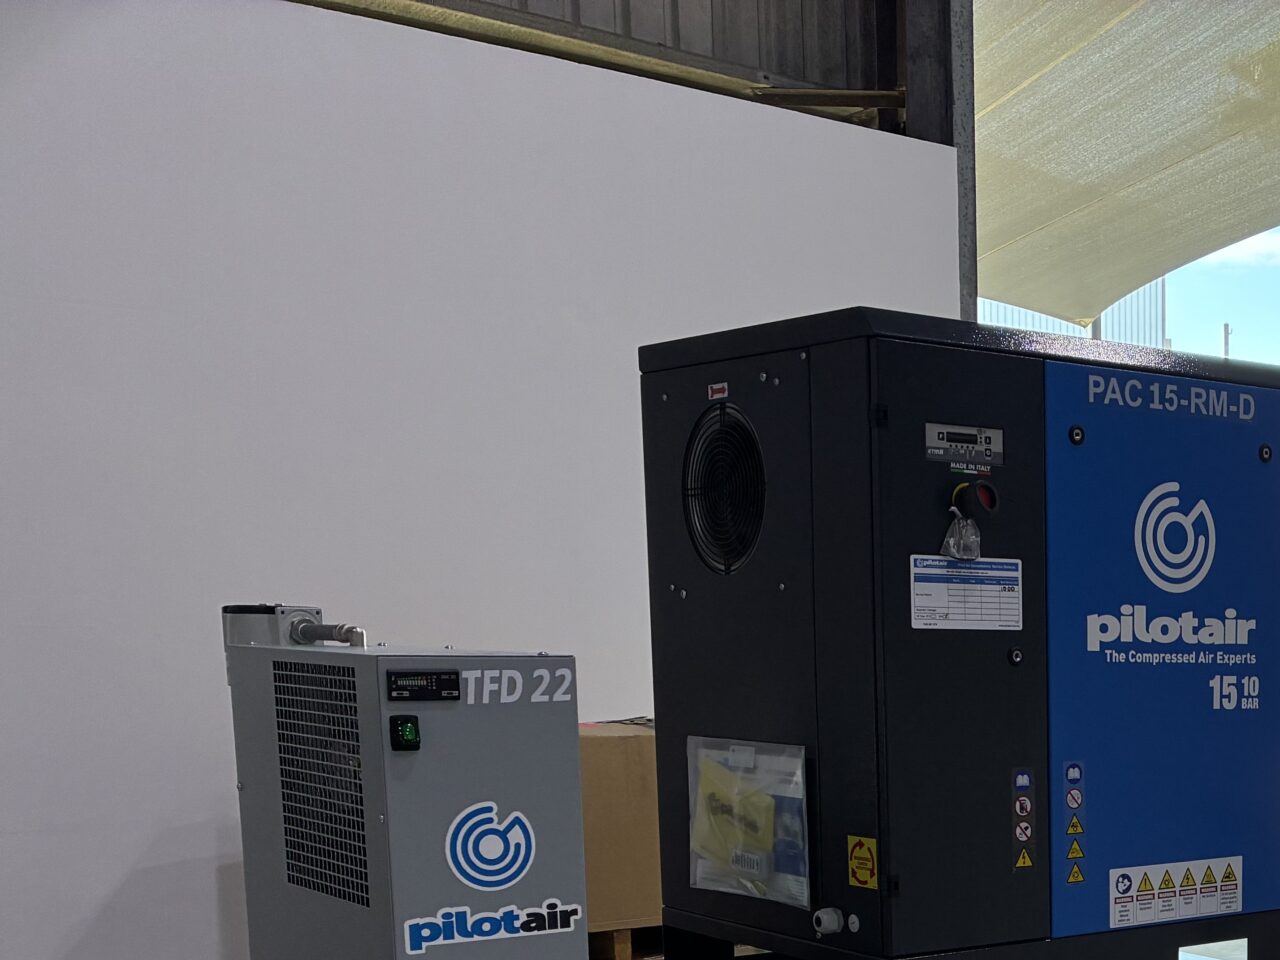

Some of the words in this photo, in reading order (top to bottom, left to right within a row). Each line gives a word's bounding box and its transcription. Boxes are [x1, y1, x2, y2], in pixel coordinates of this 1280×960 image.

[1088, 375, 1143, 408] PAC
[1150, 382, 1256, 421] 15-RM-D
[950, 461, 967, 470] MADE
[968, 463, 976, 471] IN
[976, 464, 991, 472] ITALY
[1087, 604, 1257, 652] pilotair
[1104, 650, 1126, 663] The
[1128, 650, 1196, 666] Compressed
[1198, 651, 1215, 664] Air
[1216, 651, 1257, 666] Experts
[462, 669, 523, 705] TFD
[530, 668, 573, 703] 22
[1209, 674, 1238, 710] 15
[1241, 676, 1260, 697] 10
[1241, 697, 1260, 710] BAR
[408, 902, 579, 951] pilotair
